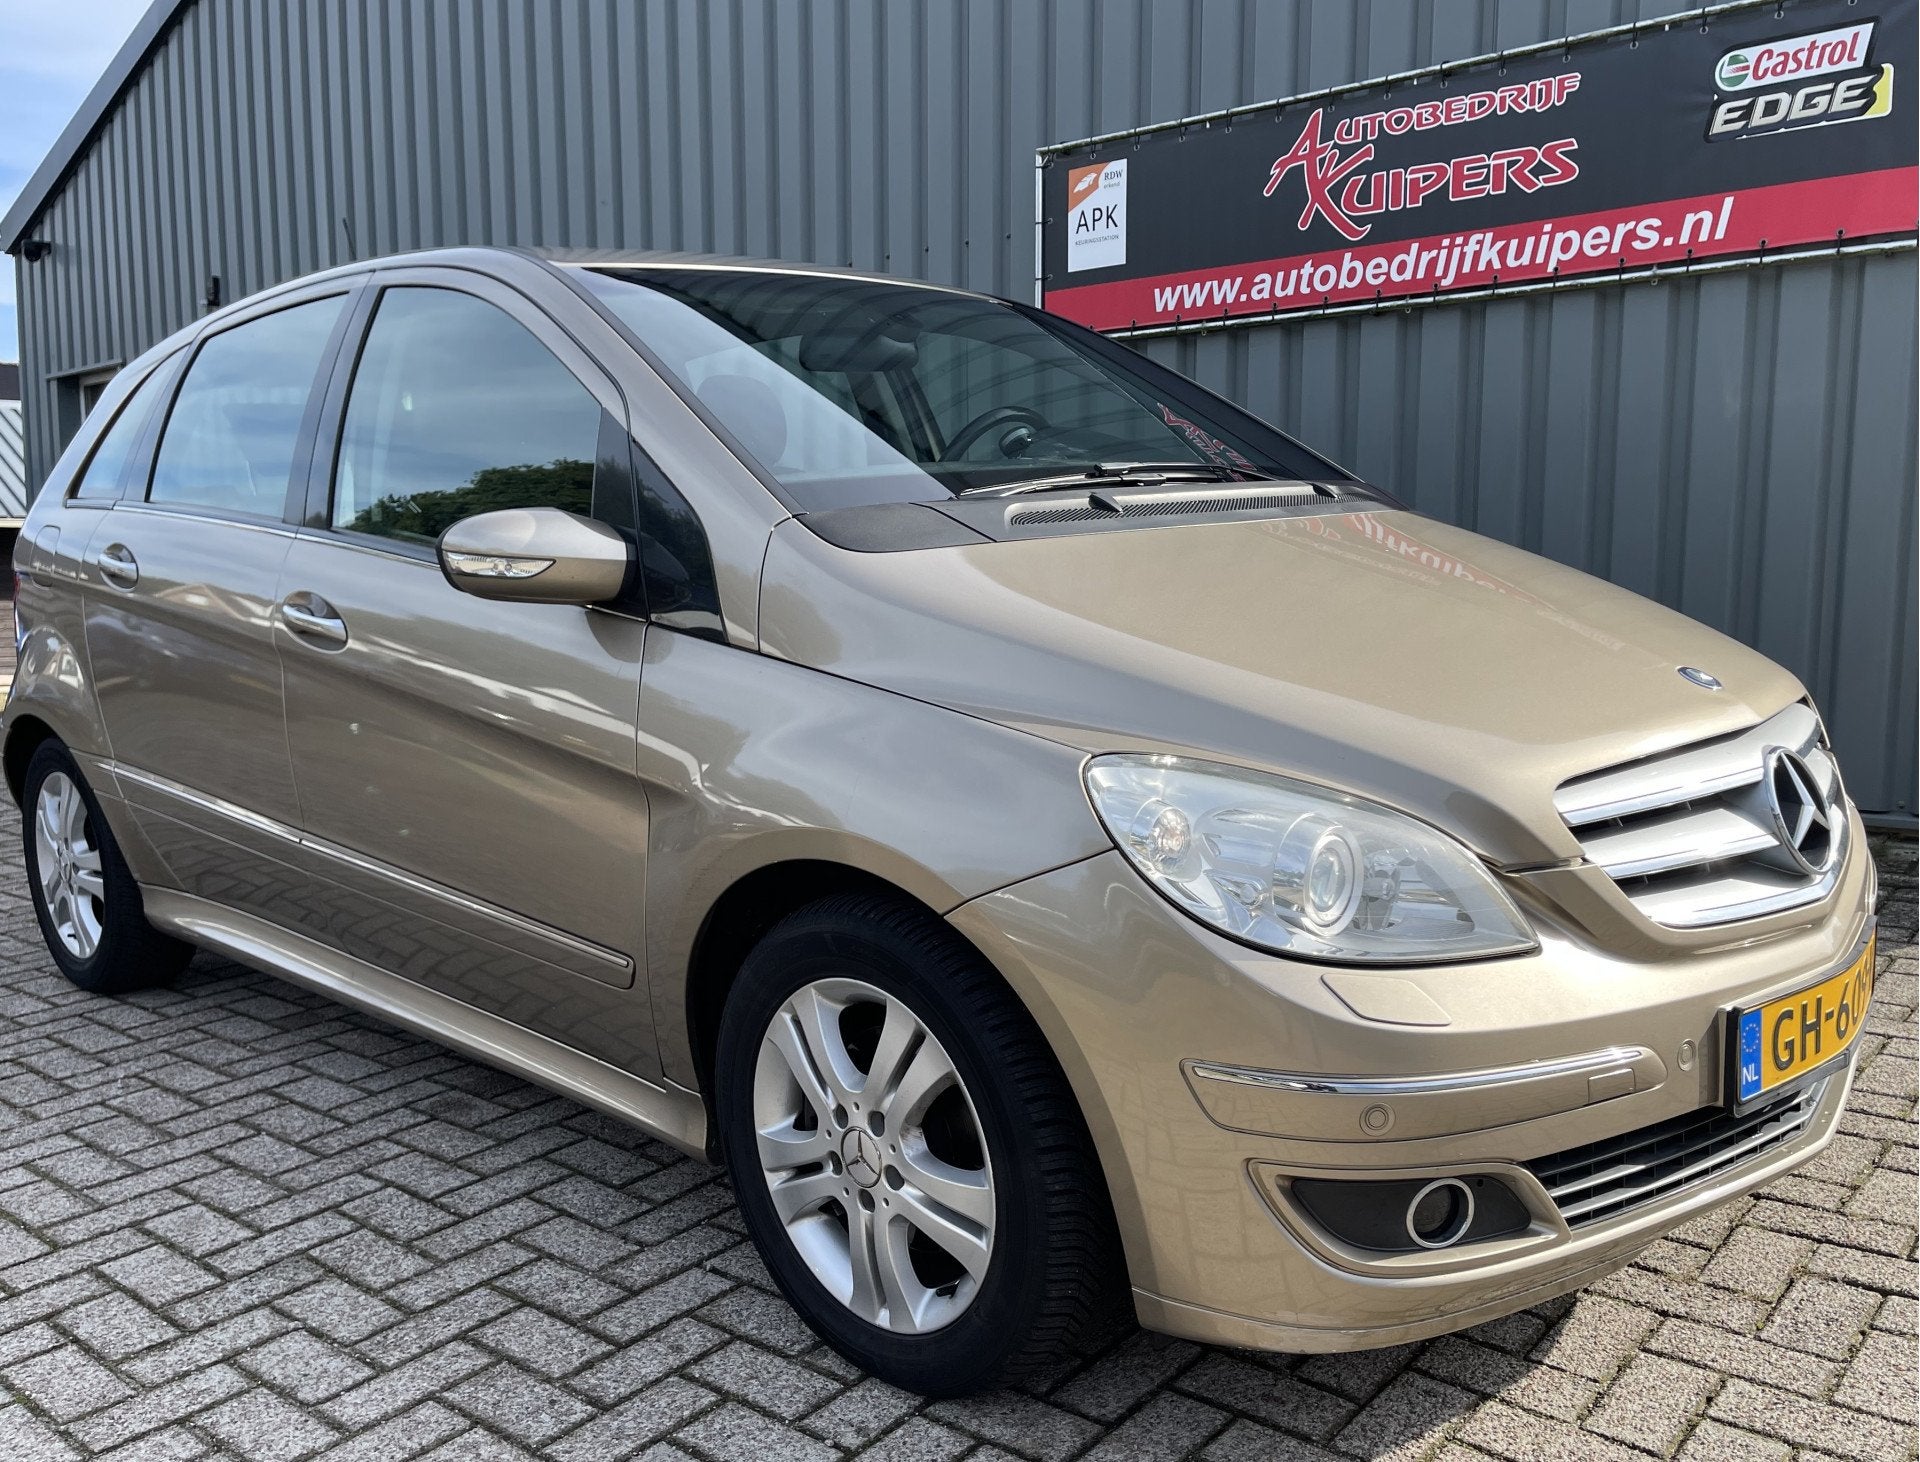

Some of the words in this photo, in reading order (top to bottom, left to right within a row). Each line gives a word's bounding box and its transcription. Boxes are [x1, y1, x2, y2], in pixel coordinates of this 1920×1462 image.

[1752, 31, 1860, 81] Castrol
[1709, 74, 1878, 135] EDGE
[1104, 169, 1123, 181] RDW
[1297, 138, 1579, 241] KUIPERS
[1075, 204, 1118, 234] APK
[1153, 196, 1735, 313] www.autobedrijfkuipers.nl
[1742, 1063, 1759, 1086] NL
